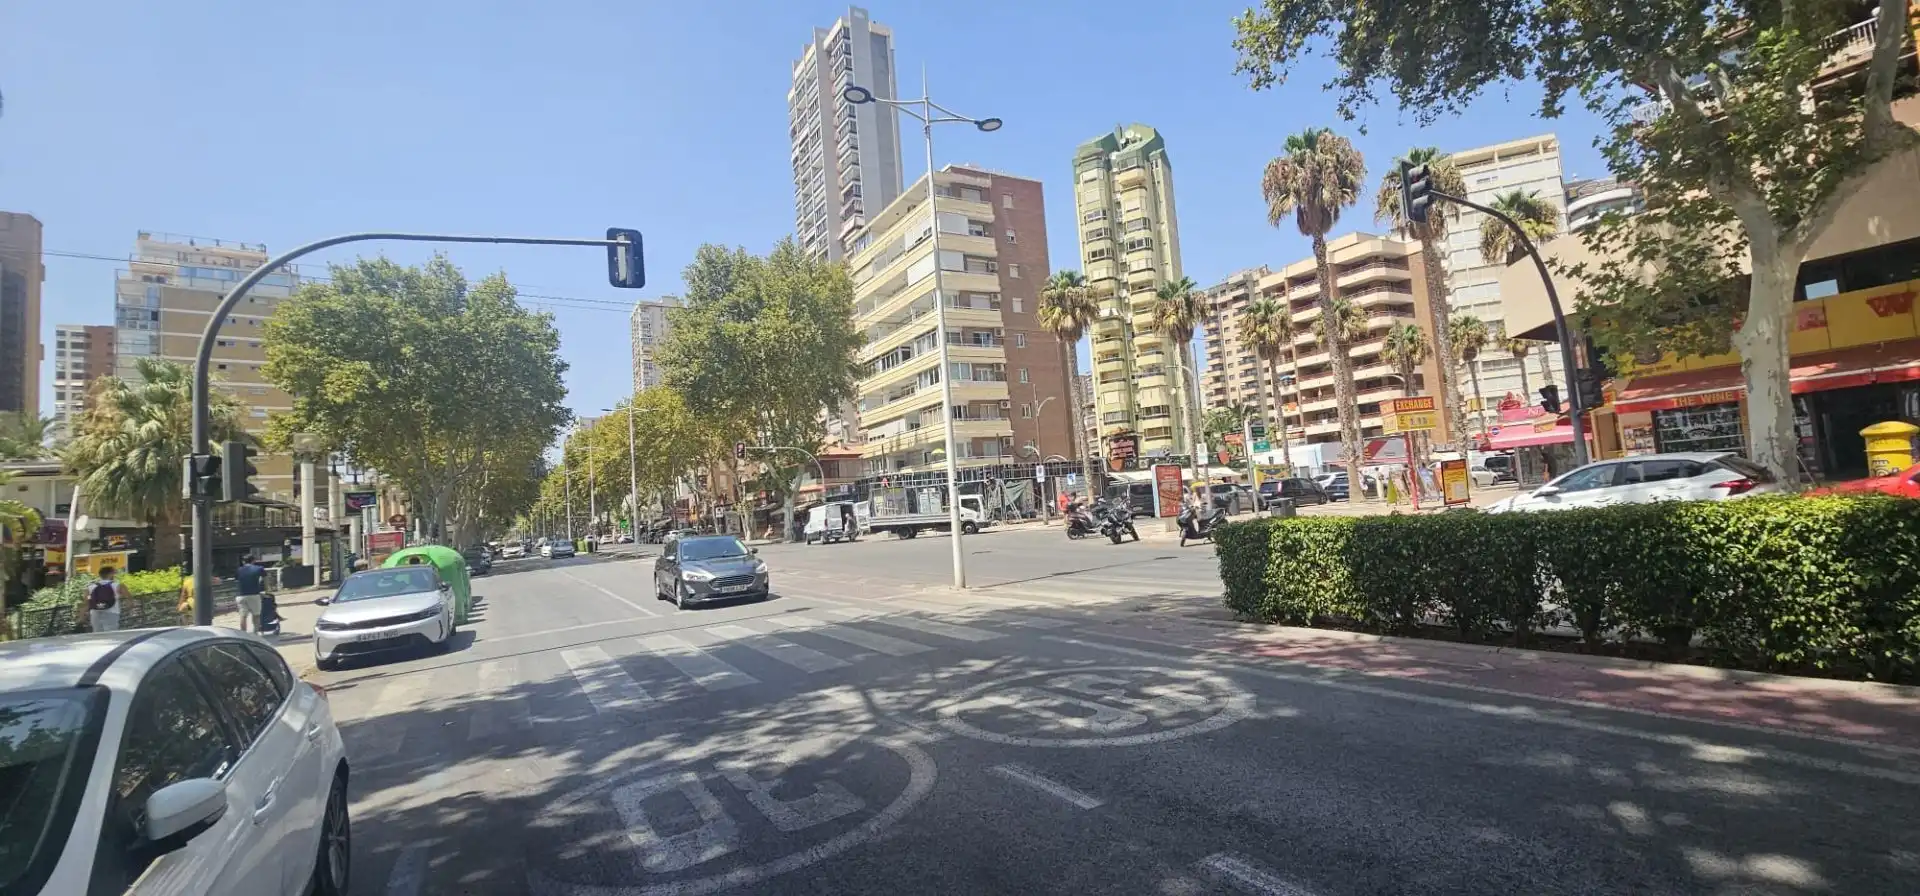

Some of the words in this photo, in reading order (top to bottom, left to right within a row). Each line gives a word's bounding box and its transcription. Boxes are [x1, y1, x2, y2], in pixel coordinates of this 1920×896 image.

[1395, 398, 1434, 410] EXCHANGE
[1671, 395, 1696, 408] THE
[1700, 391, 1733, 405] WINE
